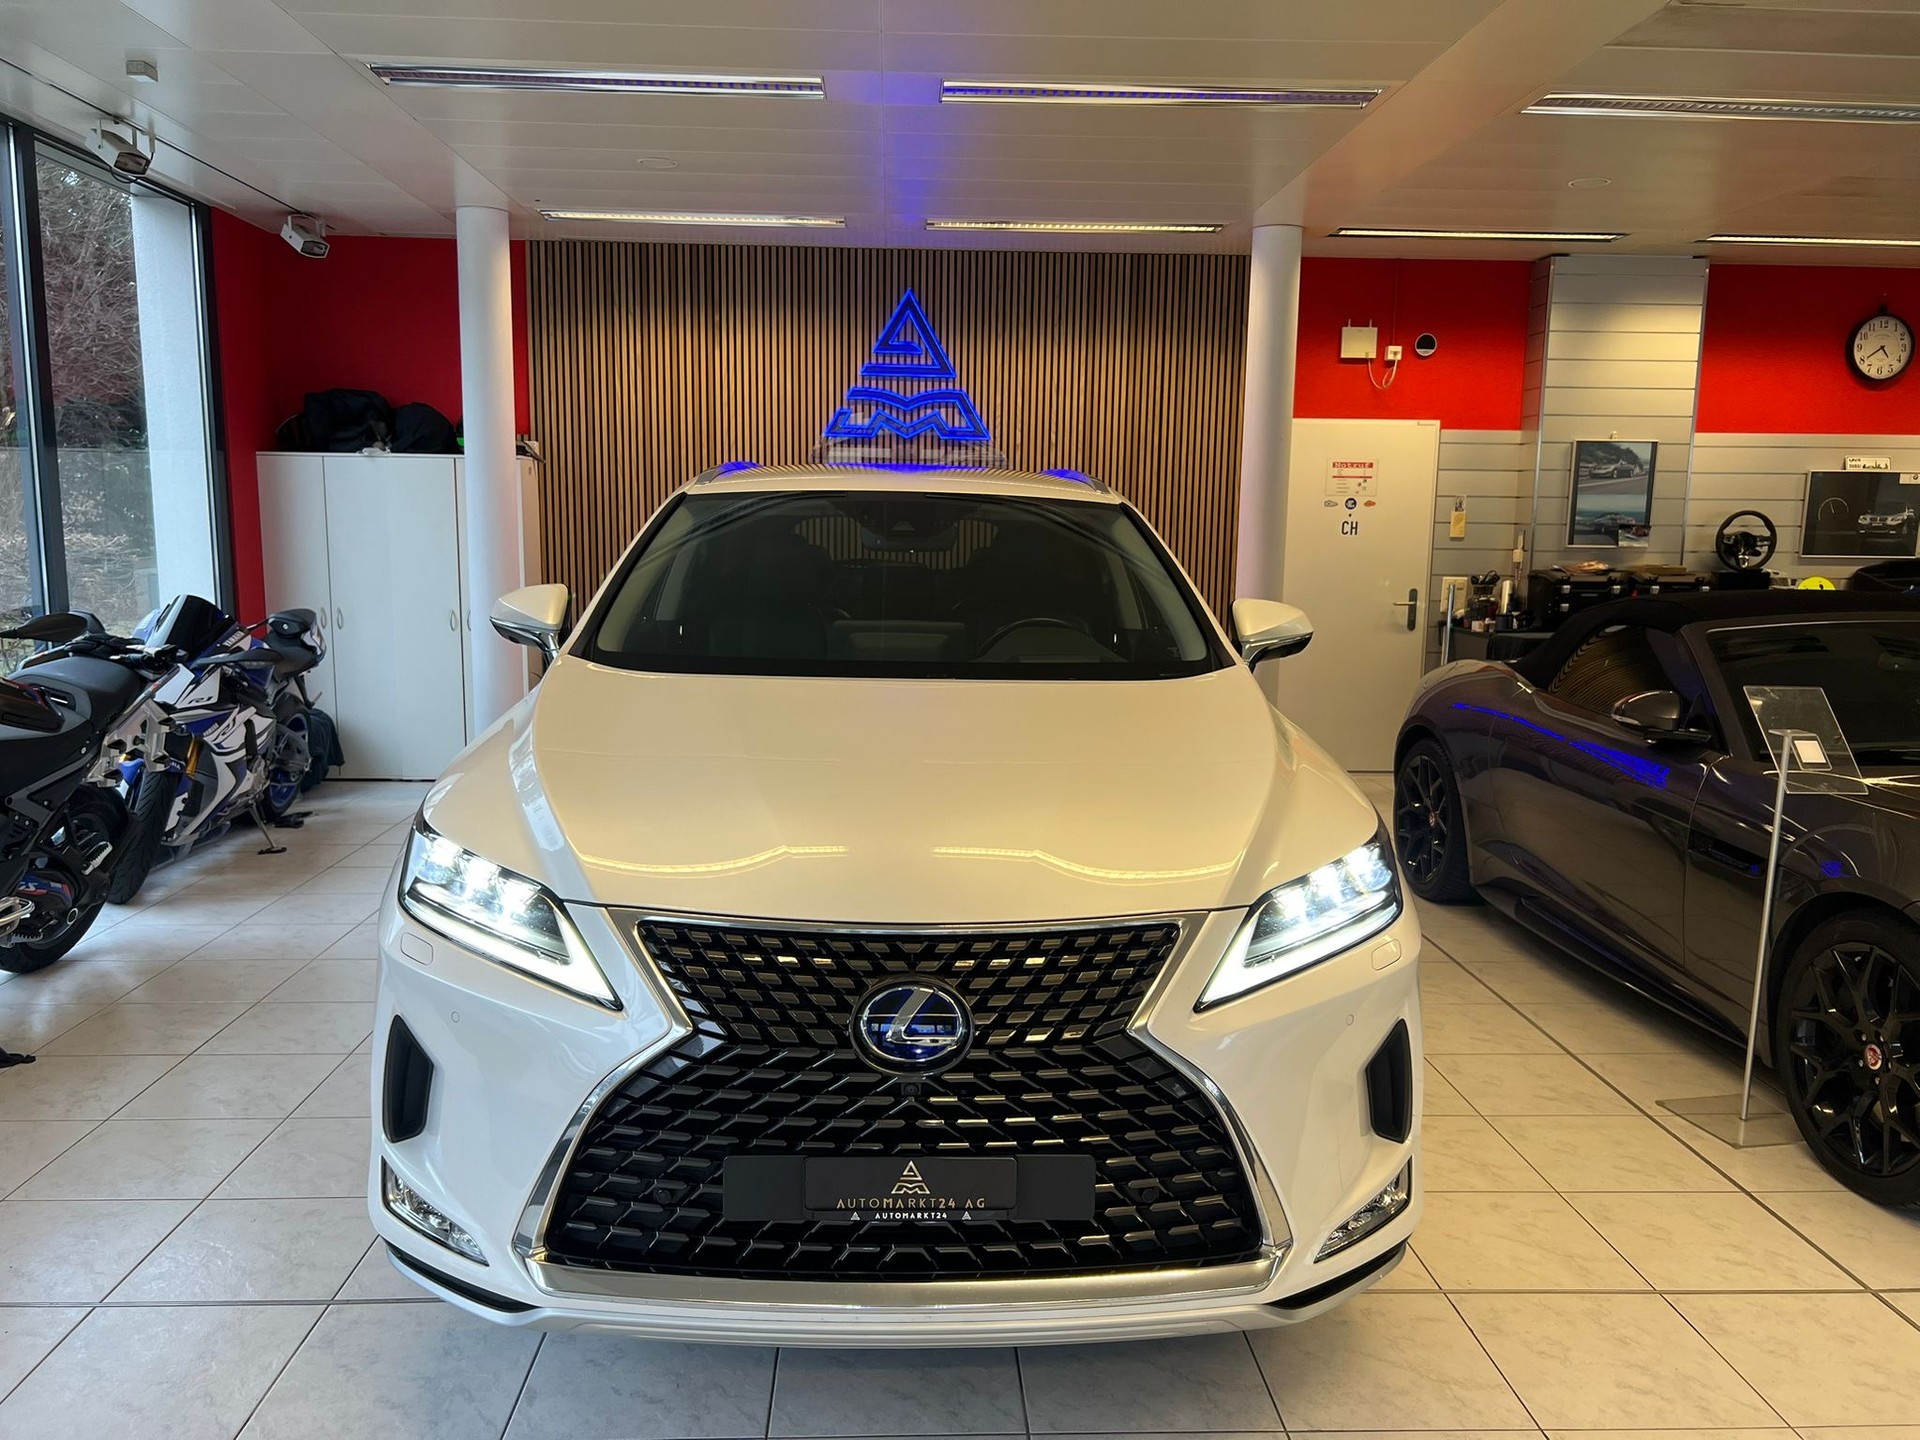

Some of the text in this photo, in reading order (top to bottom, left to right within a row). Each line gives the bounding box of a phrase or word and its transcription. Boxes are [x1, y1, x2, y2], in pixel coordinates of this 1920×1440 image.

[1880, 320, 1889, 328] 12
[1894, 323, 1898, 331] 1
[1860, 331, 1868, 340] 10
[1900, 331, 1905, 340] 2
[1857, 343, 1862, 352] 9
[1901, 342, 1907, 352] 3
[1859, 355, 1866, 365] 8
[1896, 354, 1902, 363] 4
[1867, 363, 1872, 373] 7
[1876, 366, 1883, 375] 6
[1887, 364, 1894, 374] 5
[1341, 520, 1358, 536] CH
[836, 1198, 985, 1209] AUTOMARKT24 AG
[874, 1212, 948, 1220] AUTOMARKT24
